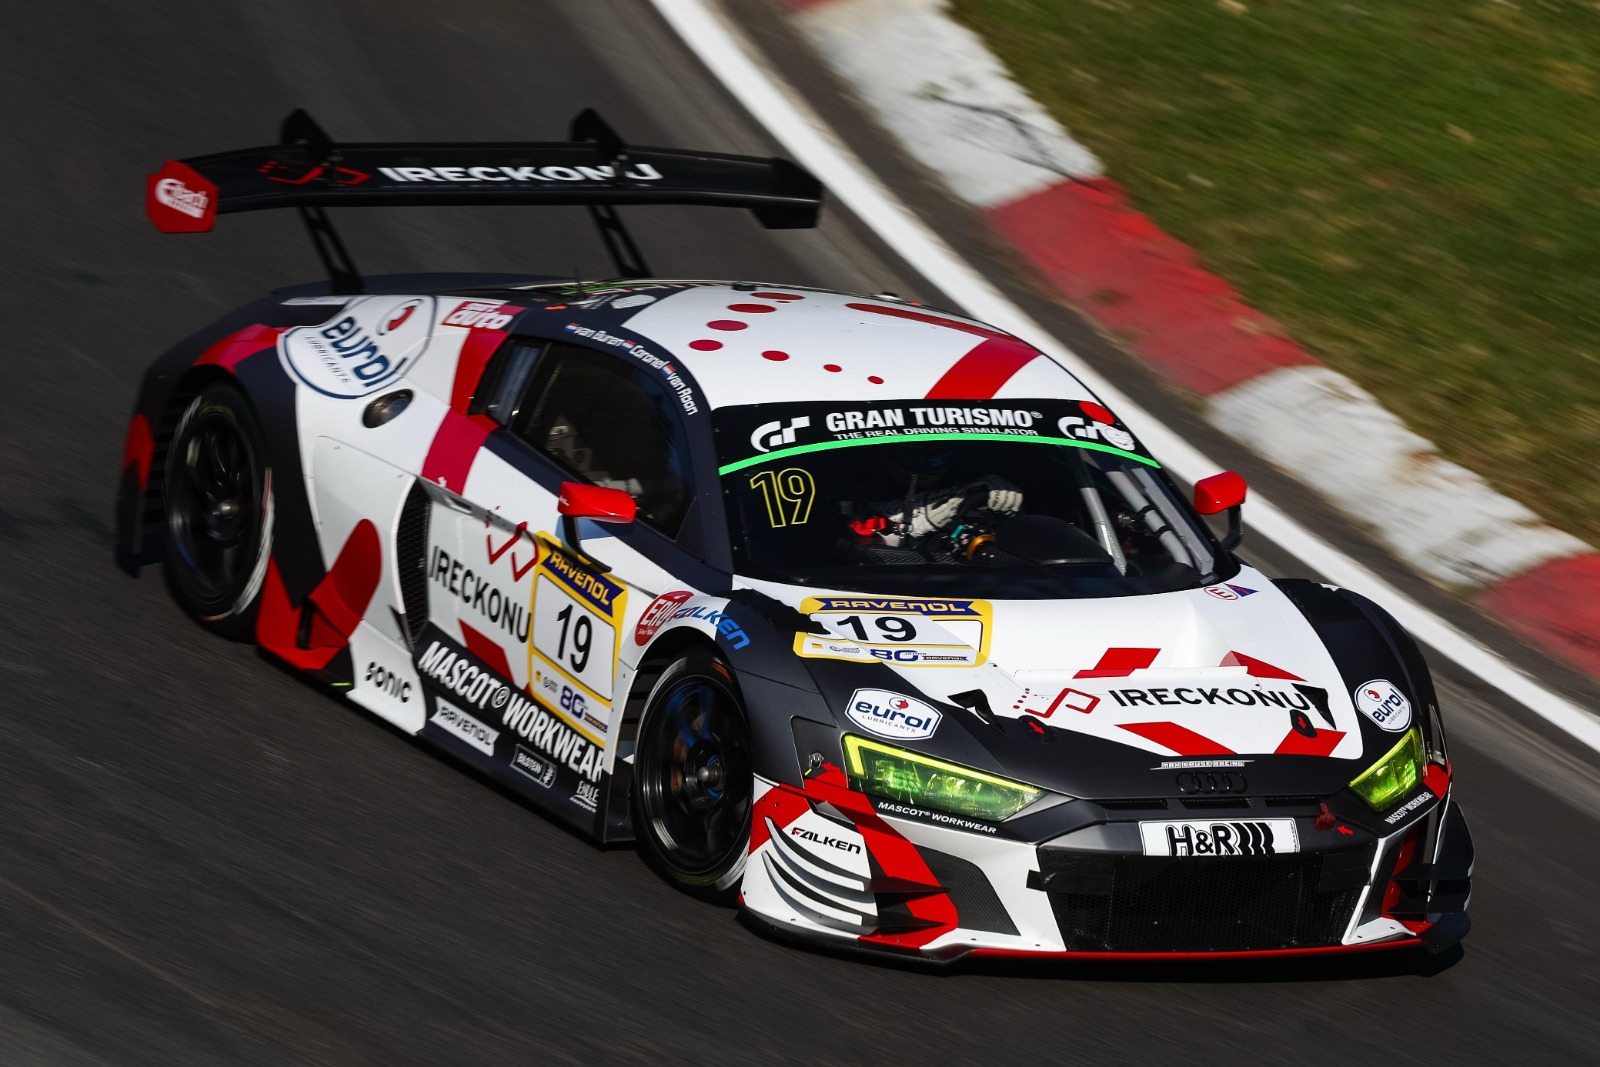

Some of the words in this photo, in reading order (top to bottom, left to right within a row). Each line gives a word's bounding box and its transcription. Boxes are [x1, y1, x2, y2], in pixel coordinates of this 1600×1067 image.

[445, 309, 514, 329] auto
[573, 326, 595, 338] van
[591, 330, 625, 347] Buren
[320, 315, 407, 388] eurol
[628, 344, 670, 370] Coronel
[666, 372, 687, 391] van
[825, 407, 905, 433] GRAN
[833, 432, 865, 441] THE
[865, 428, 901, 438] REAL
[902, 426, 960, 436] DRIVING
[960, 426, 1040, 437] SIMULATOR
[749, 467, 816, 529] 19
[549, 550, 610, 606] RAVENOL
[427, 545, 532, 644] IRECKONU
[830, 600, 966, 612] RAVENOL
[640, 598, 682, 627] ERU
[556, 603, 593, 674] 19
[666, 605, 751, 651] FALKEN
[836, 615, 918, 642] 19
[869, 648, 919, 662] 80
[560, 685, 586, 719] 80
[1108, 687, 1311, 711] IRECKONU
[1371, 687, 1405, 723] eurol
[439, 705, 492, 746] RAVENOL
[855, 701, 933, 731] eurol
[861, 714, 916, 733] LUBRICANTS
[931, 812, 998, 834] WORKWEAR
[791, 826, 862, 856] FALKEN
[1166, 824, 1236, 857] H&R
